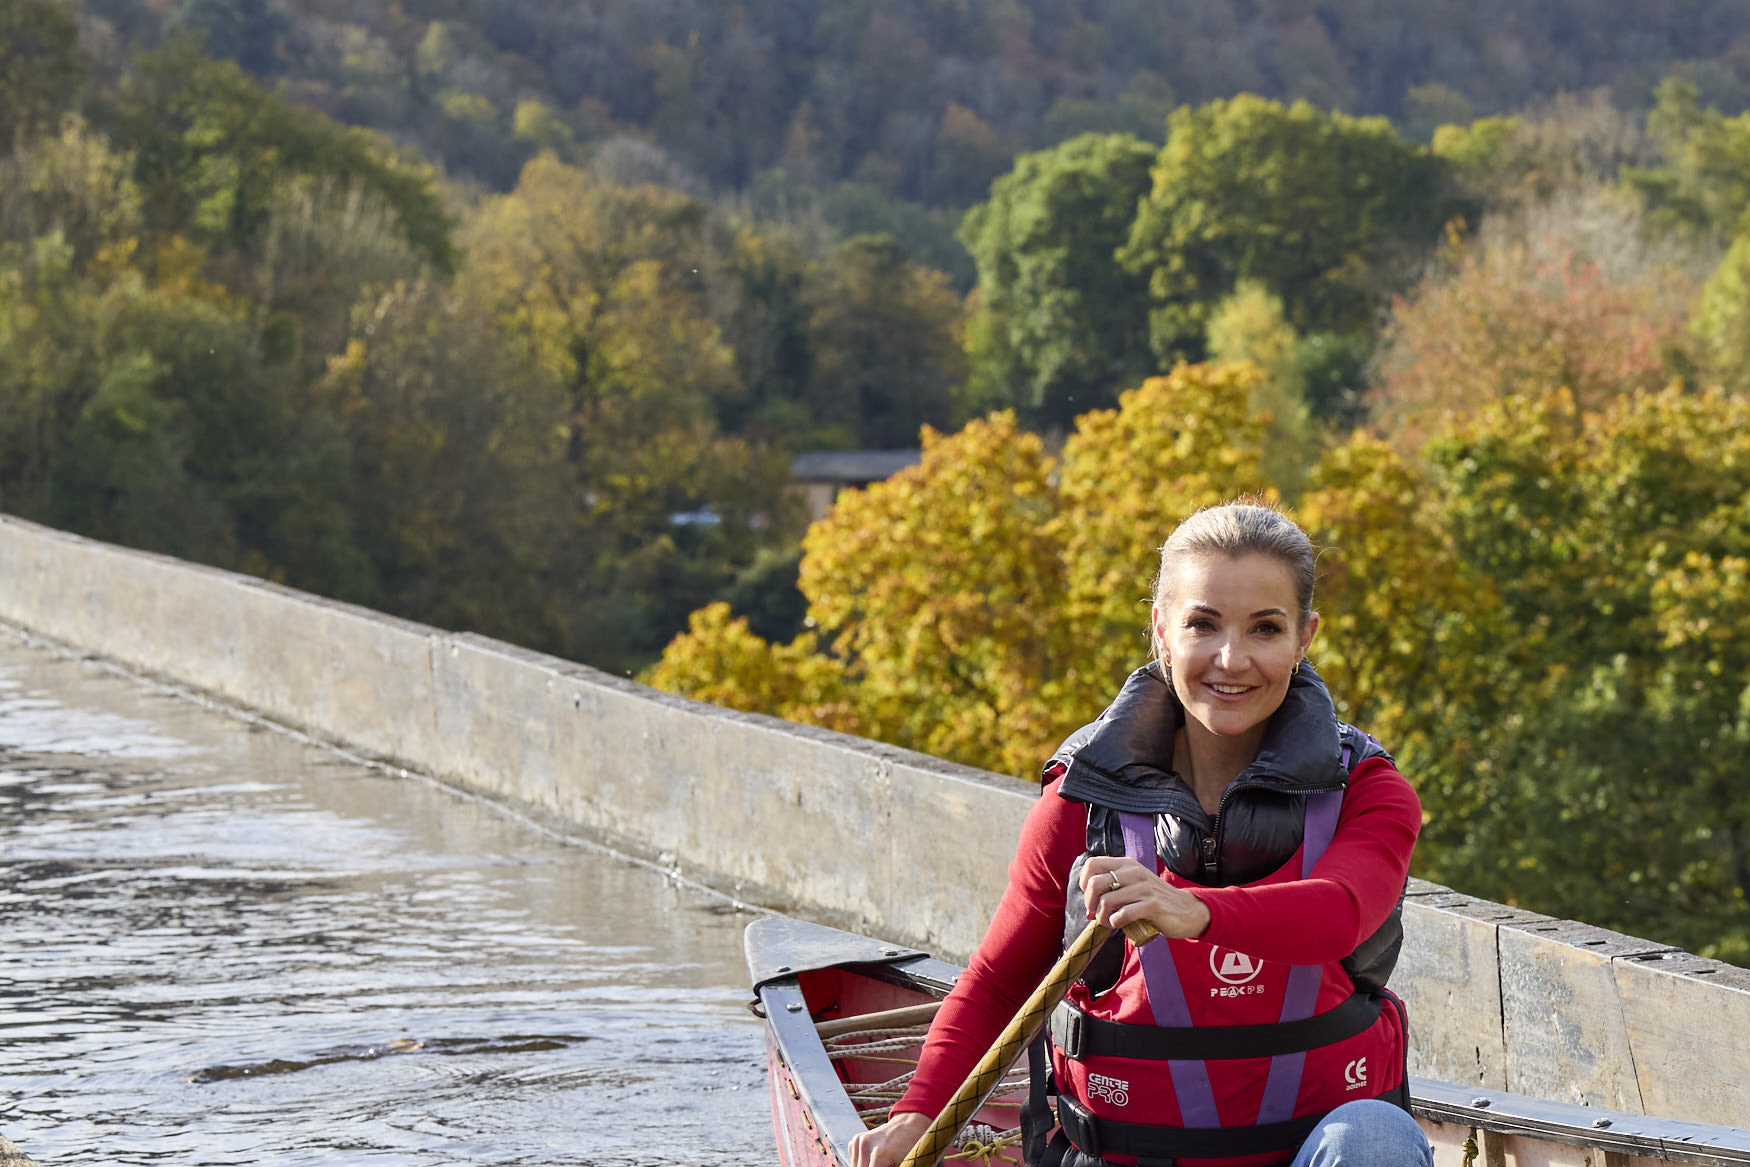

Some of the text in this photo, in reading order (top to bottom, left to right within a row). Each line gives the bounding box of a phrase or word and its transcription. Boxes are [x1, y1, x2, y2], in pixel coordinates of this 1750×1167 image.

[1088, 1072, 1129, 1091] CENTRE
[1344, 1056, 1367, 1084] CE
[1087, 1081, 1129, 1107] PRO
